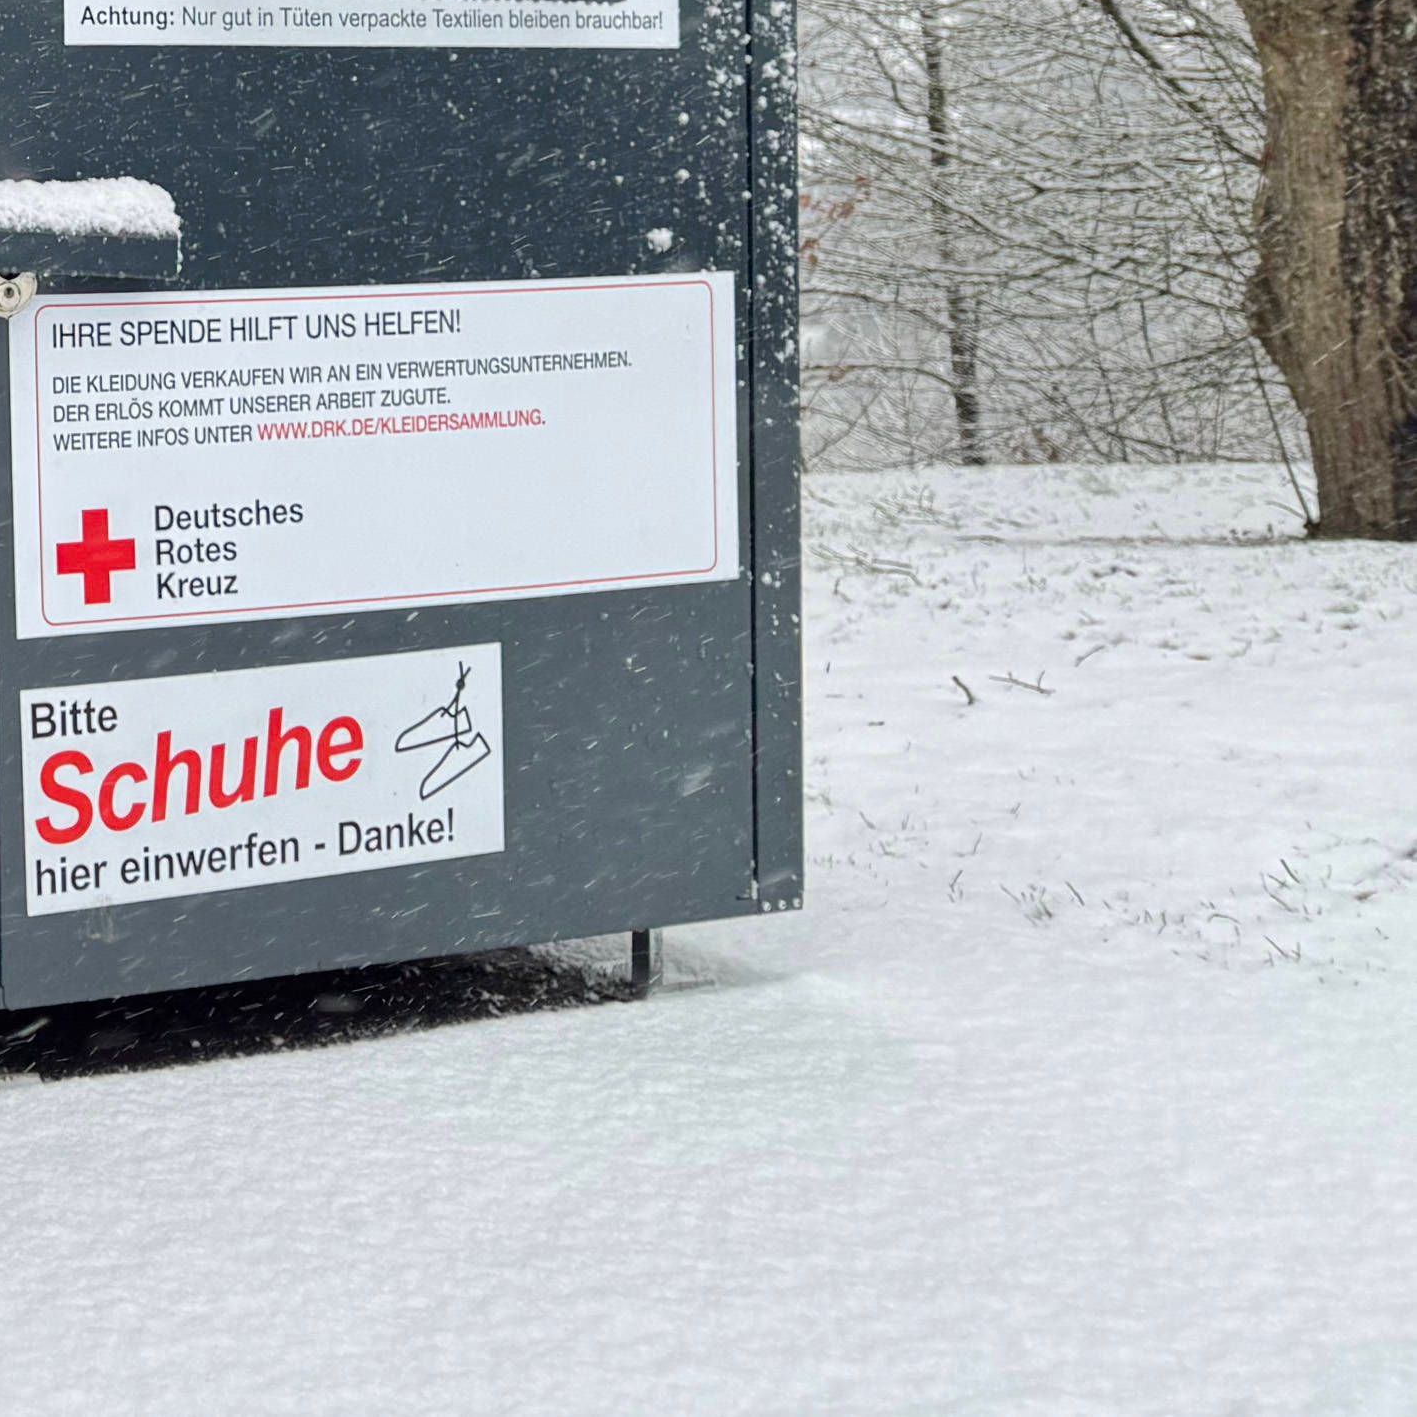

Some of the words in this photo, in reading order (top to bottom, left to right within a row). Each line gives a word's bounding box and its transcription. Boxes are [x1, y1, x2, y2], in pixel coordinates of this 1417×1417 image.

[80, 5, 175, 30] Achtung:
[181, 6, 216, 26] Nur
[221, 8, 252, 31] gut
[257, 7, 274, 27] in
[279, 6, 333, 28] Tüten
[340, 9, 427, 32] verpackte
[431, 9, 504, 28] Textilien
[509, 9, 570, 29] bleiben
[575, 10, 663, 30] brauchbar!
[52, 321, 113, 349] IHRE
[119, 318, 222, 346] SPENDE
[230, 316, 298, 343] HILFT
[305, 313, 356, 339] UNS
[364, 309, 462, 337] HELFEN!
[52, 375, 82, 394] DIE
[86, 372, 176, 393] KLEIDUNG
[180, 367, 284, 389] VERKAUFEN
[289, 365, 322, 384] WIR
[326, 363, 351, 383] AN
[355, 362, 383, 381] EIN
[386, 350, 633, 379] VERWERTUNGSUNTERNEHMEN.
[52, 404, 90, 423] DER
[95, 397, 153, 421] ERLÖS
[158, 398, 225, 418] KOMMT
[229, 393, 311, 416] UNSERER
[315, 390, 376, 412] ARBEIT
[380, 387, 451, 407] ZUGUTE.
[53, 430, 132, 452] WEITERE
[137, 427, 189, 448] INFOS
[194, 424, 253, 444] UNTER
[257, 408, 546, 441] WWW.DRK.DE/KLEIDERSAMMLUNG.
[154, 499, 304, 531] Deutsches
[155, 537, 238, 565] Rotes
[156, 572, 239, 600] Kreuz
[30, 698, 118, 740] Bitte
[34, 706, 365, 845] Schuhe
[35, 855, 107, 897] hier
[120, 832, 300, 885] einwerfen
[337, 806, 455, 857] Danke!
